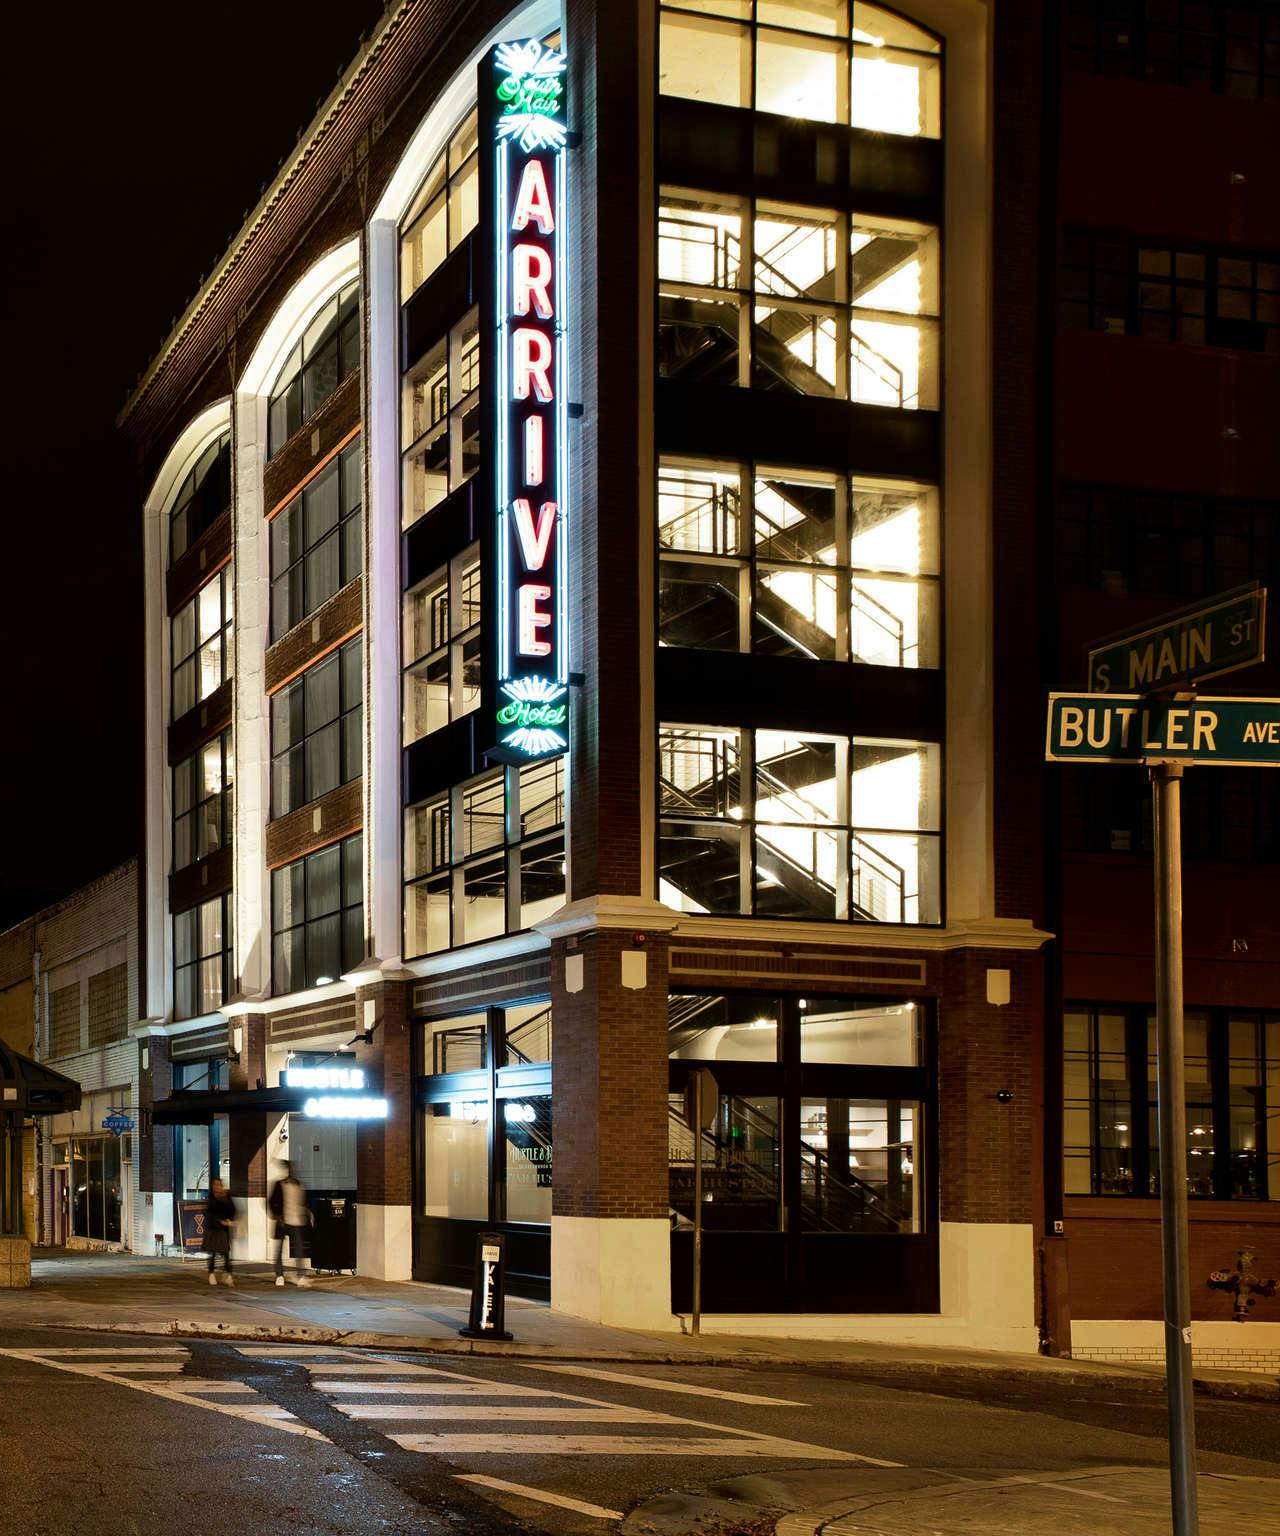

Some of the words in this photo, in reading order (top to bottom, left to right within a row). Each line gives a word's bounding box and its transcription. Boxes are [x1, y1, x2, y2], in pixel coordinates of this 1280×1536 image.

[506, 91, 561, 114] Main
[510, 159, 557, 657] ARRIVE
[1095, 663, 1110, 693] S
[1128, 622, 1212, 689] MAIN
[1231, 618, 1255, 646] ST
[498, 699, 566, 725] Hotel
[1059, 706, 1218, 751] BUTLER
[1243, 722, 1280, 744] AVE
